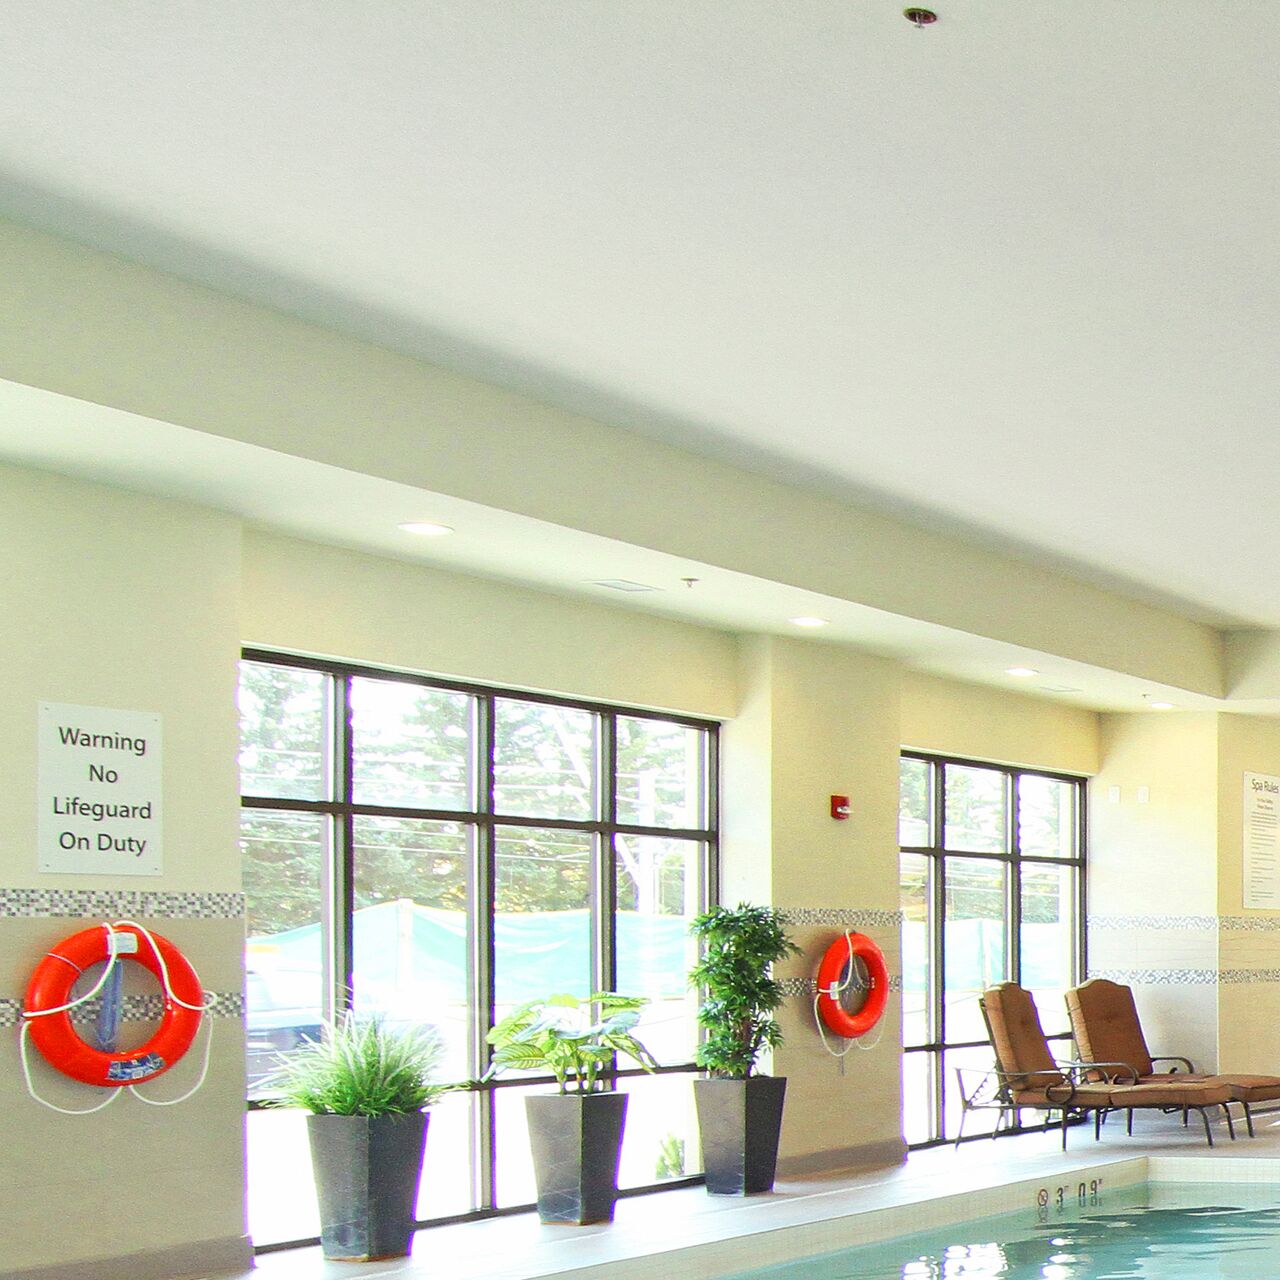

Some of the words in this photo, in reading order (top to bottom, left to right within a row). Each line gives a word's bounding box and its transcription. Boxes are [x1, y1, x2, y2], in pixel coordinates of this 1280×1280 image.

[58, 726, 146, 757] Warning
[89, 763, 119, 784] No
[53, 796, 152, 822] Lifeguard
[59, 831, 90, 850] On
[98, 833, 147, 857] Duty
